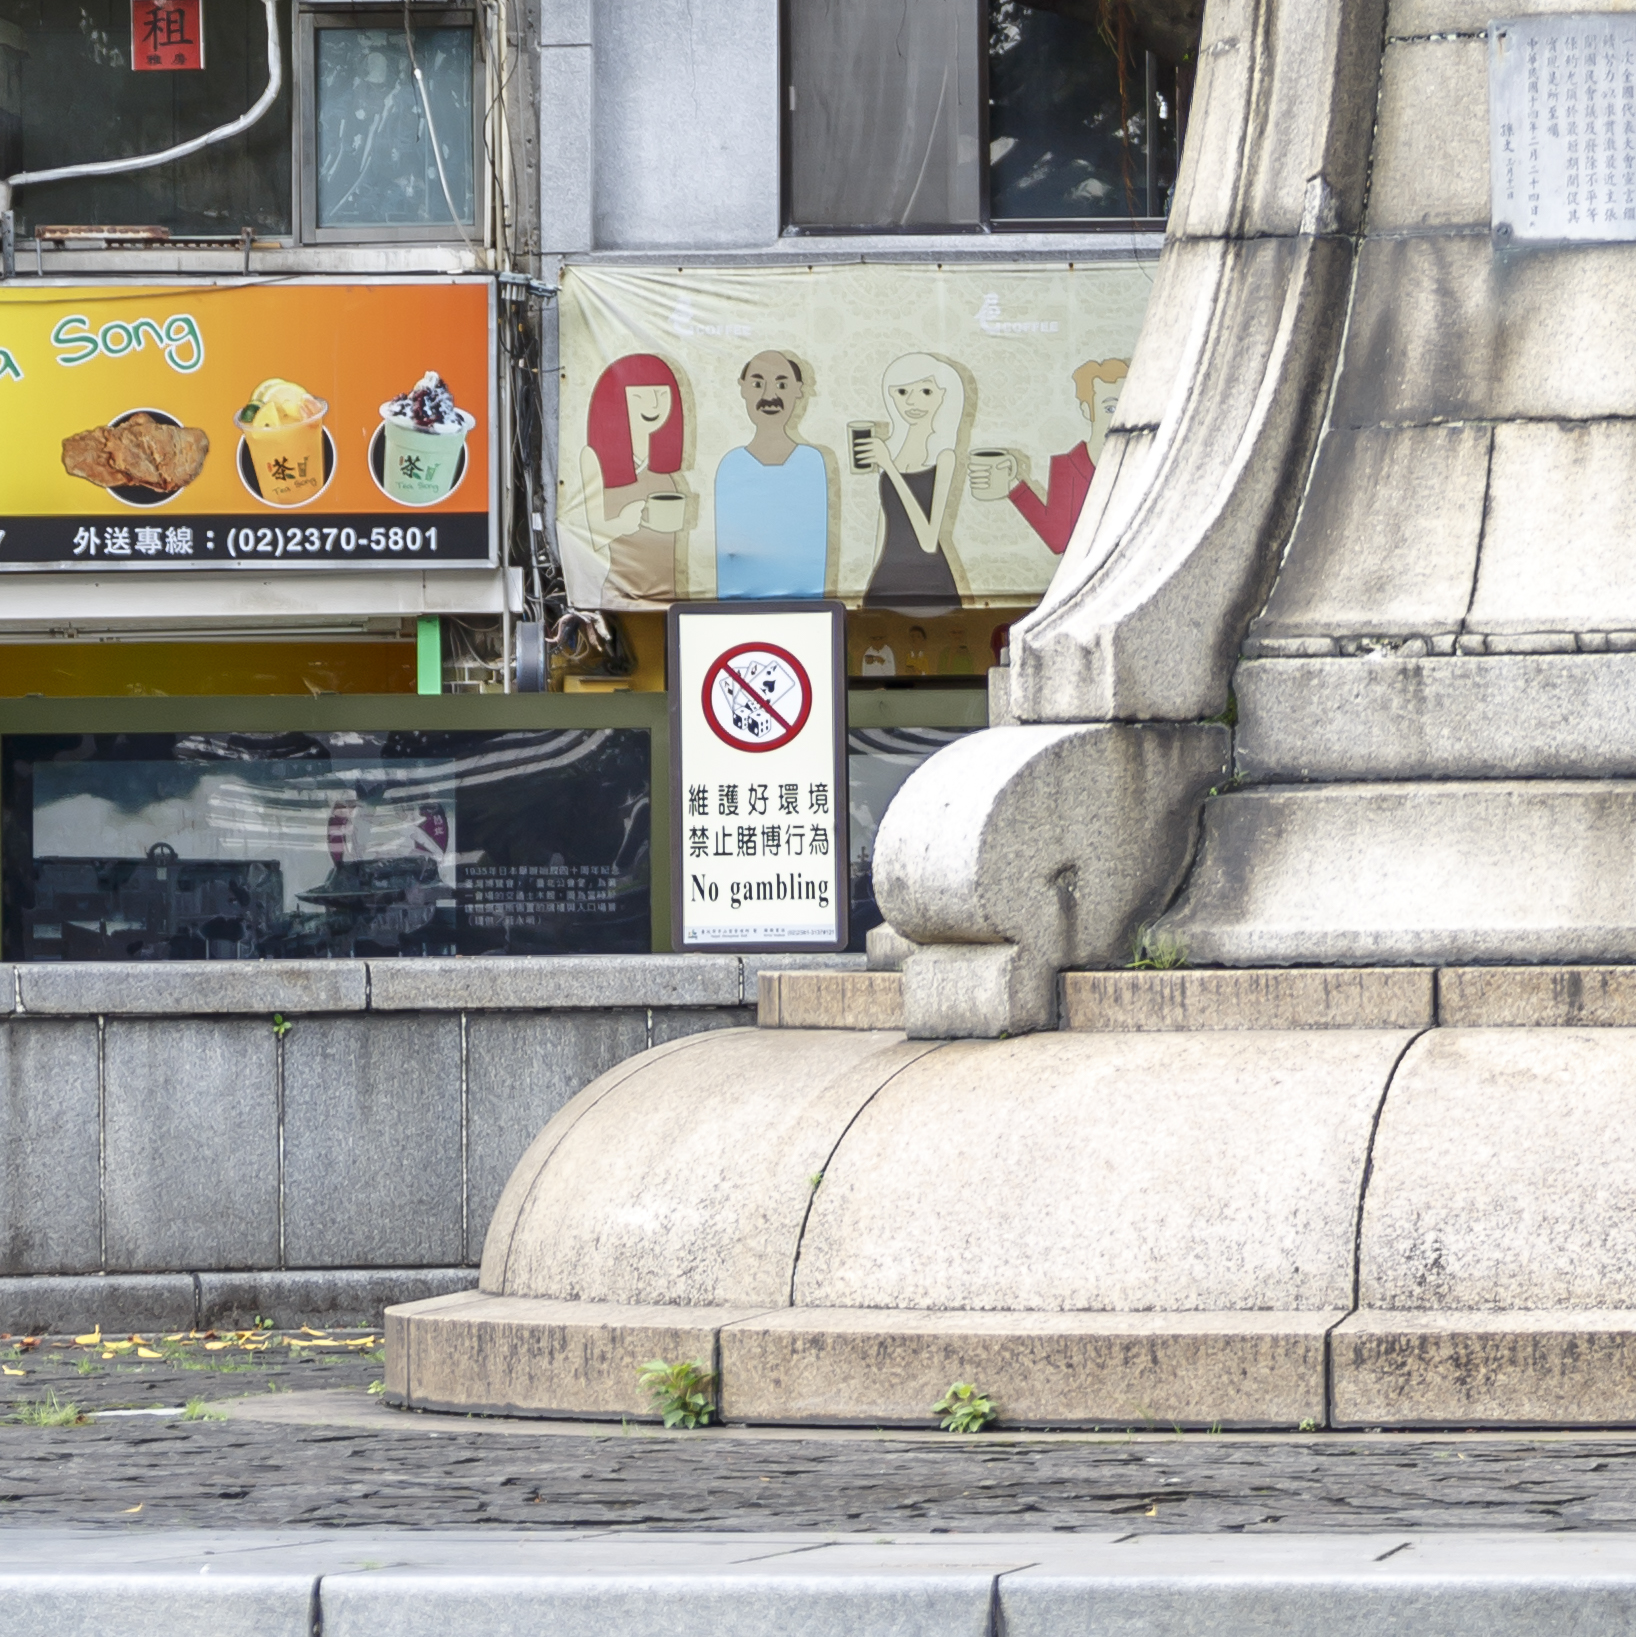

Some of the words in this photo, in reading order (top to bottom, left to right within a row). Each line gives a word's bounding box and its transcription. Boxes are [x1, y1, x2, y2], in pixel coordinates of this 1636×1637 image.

[142, 7, 194, 52] 租
[51, 314, 204, 374] Song
[271, 456, 295, 481] 茶
[399, 454, 424, 479] 茶
[226, 526, 439, 557] (02)2370-5801
[688, 782, 829, 818] 維護好環境
[688, 823, 829, 858] 禁止賭博行為
[691, 873, 720, 902] No
[730, 873, 830, 910] gambling
